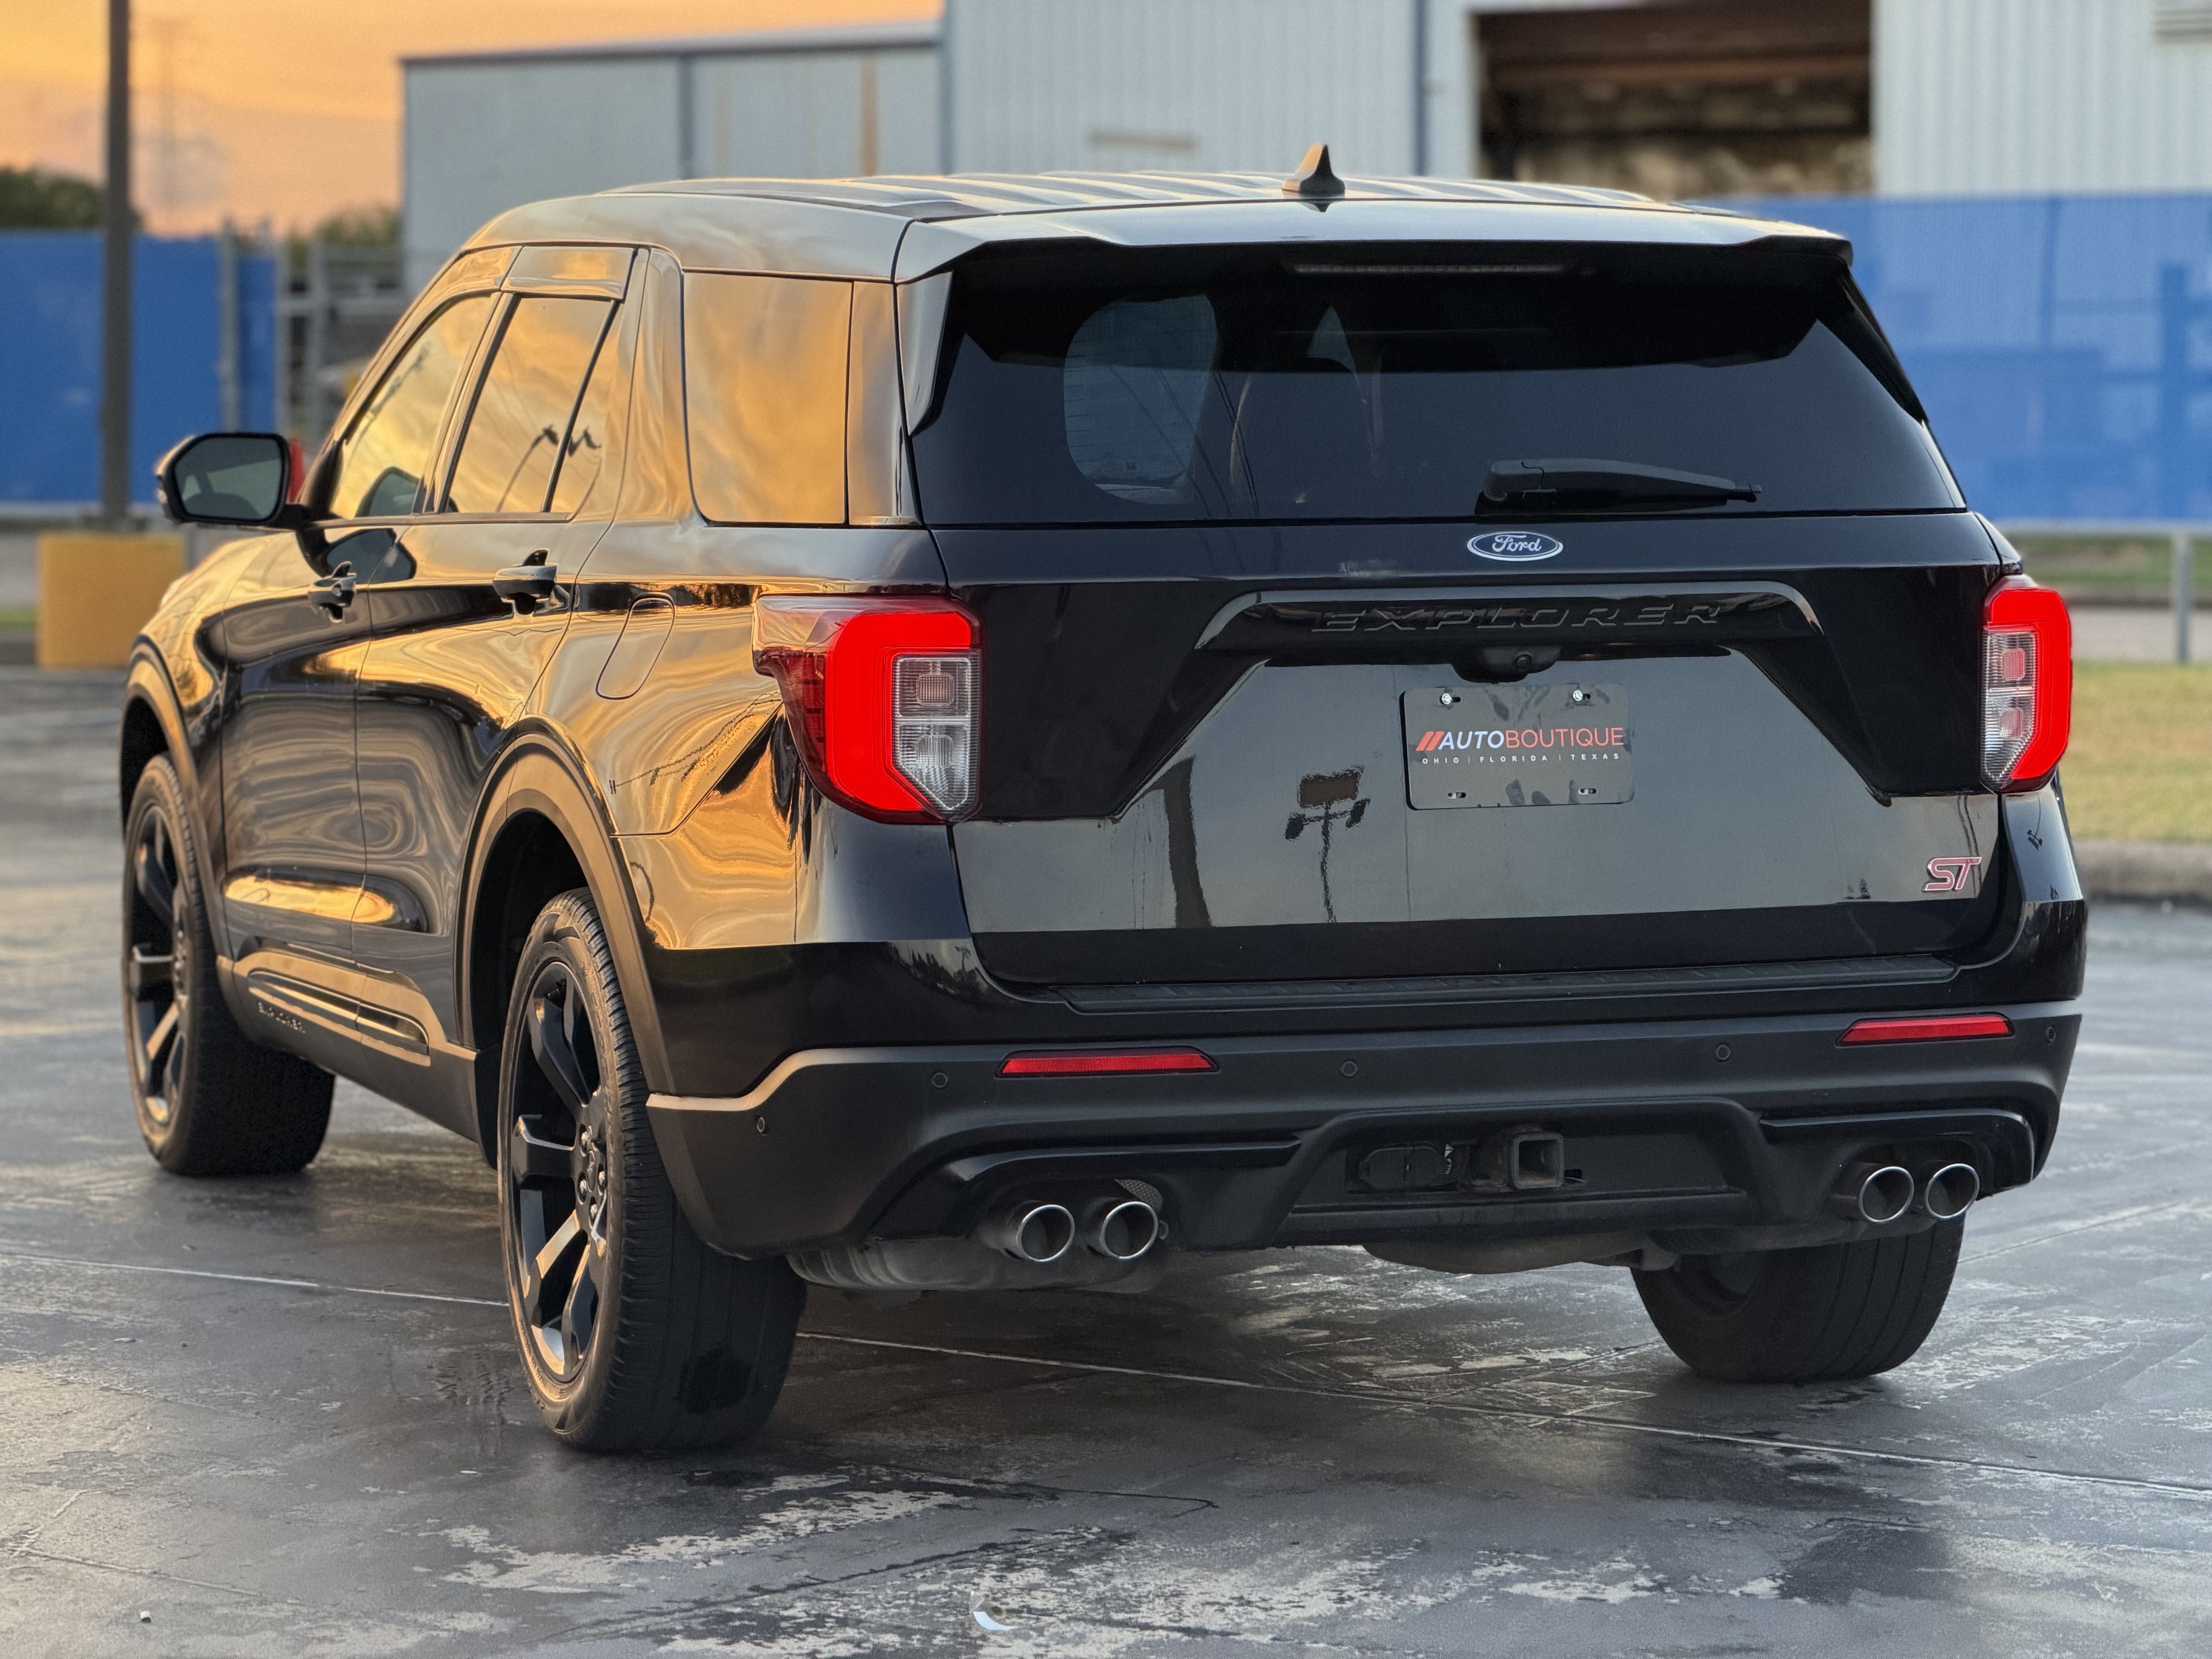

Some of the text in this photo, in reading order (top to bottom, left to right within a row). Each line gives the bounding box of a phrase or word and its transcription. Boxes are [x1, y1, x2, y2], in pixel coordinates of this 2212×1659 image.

[1492, 535, 1542, 552] Ford
[1312, 605, 1720, 632] EXPLORER
[1480, 754, 1547, 763] FLORIDA
[1922, 857, 1982, 891] ST
